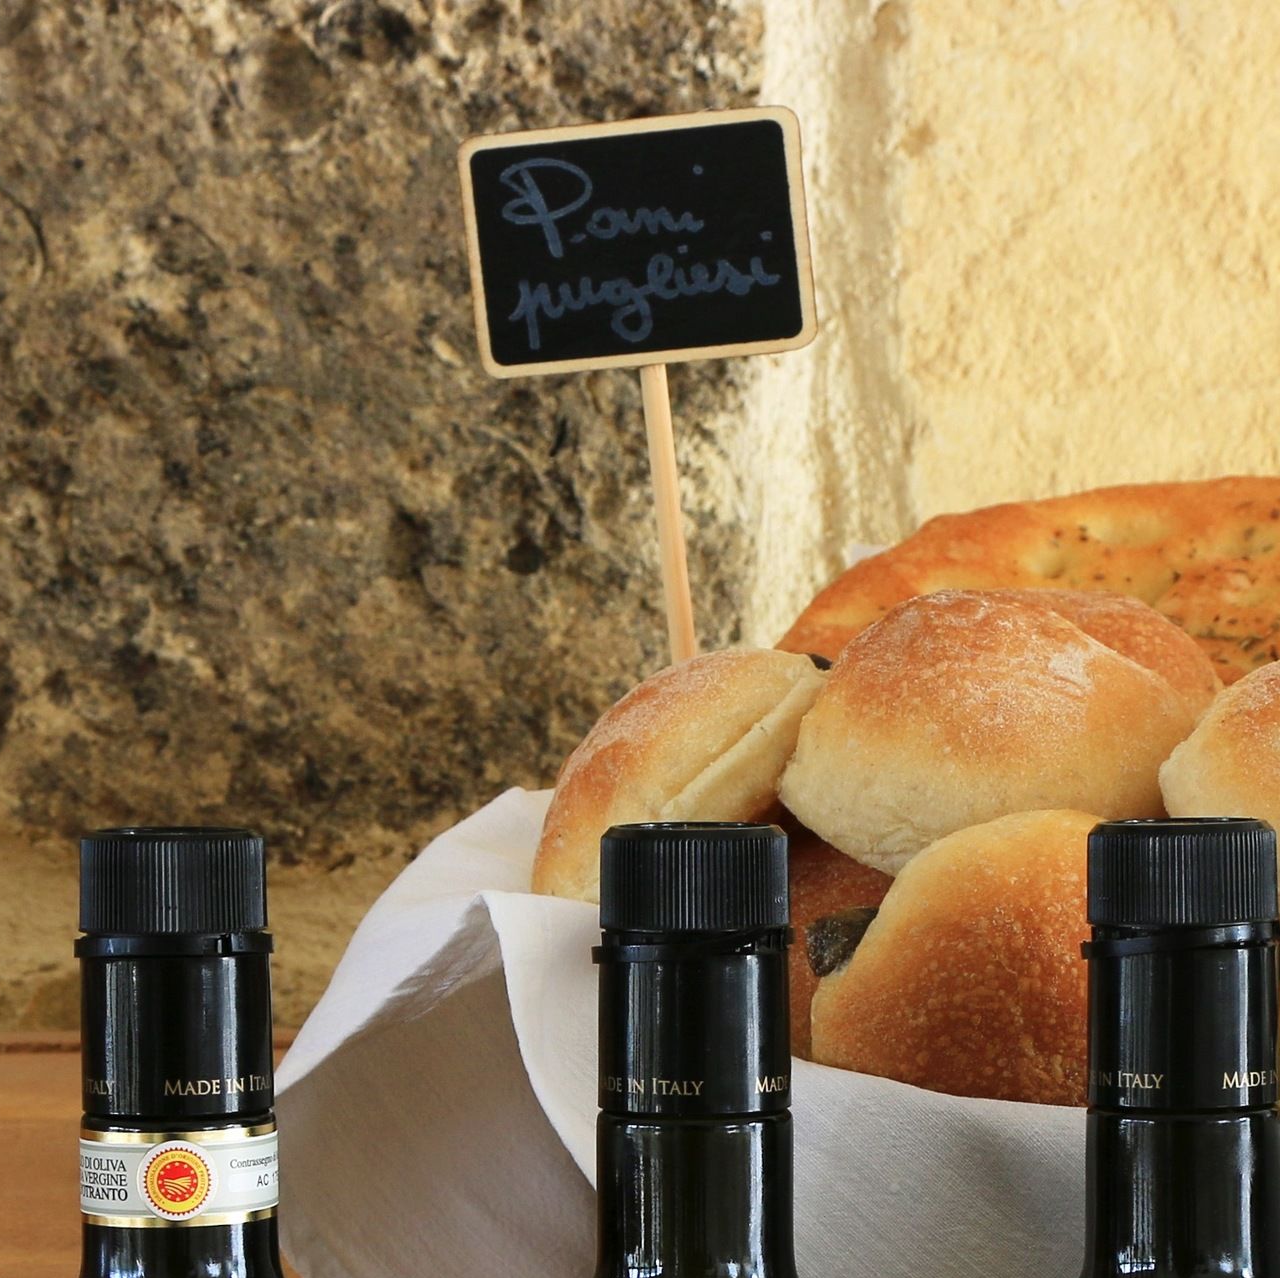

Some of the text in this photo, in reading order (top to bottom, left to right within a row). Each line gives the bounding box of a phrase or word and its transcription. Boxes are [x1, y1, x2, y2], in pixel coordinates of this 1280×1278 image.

[500, 157, 704, 258] Pani
[508, 230, 780, 350] pugliesi
[87, 1079, 115, 1096] TALY
[93, 1157, 127, 1173] OLIVA
[84, 1171, 128, 1187] VERGINE
[257, 1173, 269, 1188] AC
